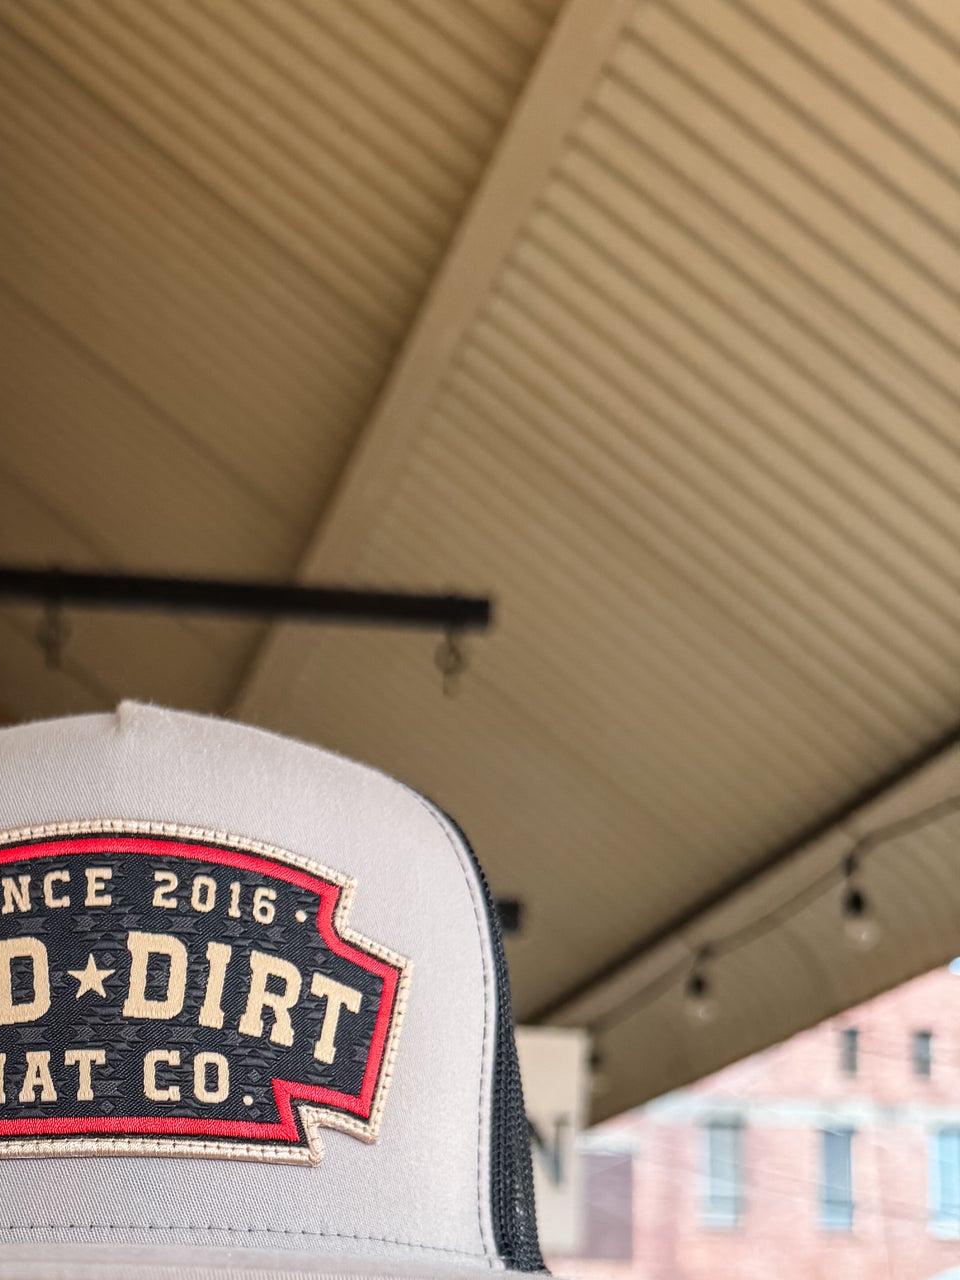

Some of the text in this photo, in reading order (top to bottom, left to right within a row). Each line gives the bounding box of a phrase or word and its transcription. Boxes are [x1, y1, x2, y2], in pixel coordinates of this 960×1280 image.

[152, 871, 277, 925] 2016
[122, 931, 362, 1065] DIRT
[143, 1049, 254, 1105] CO.
